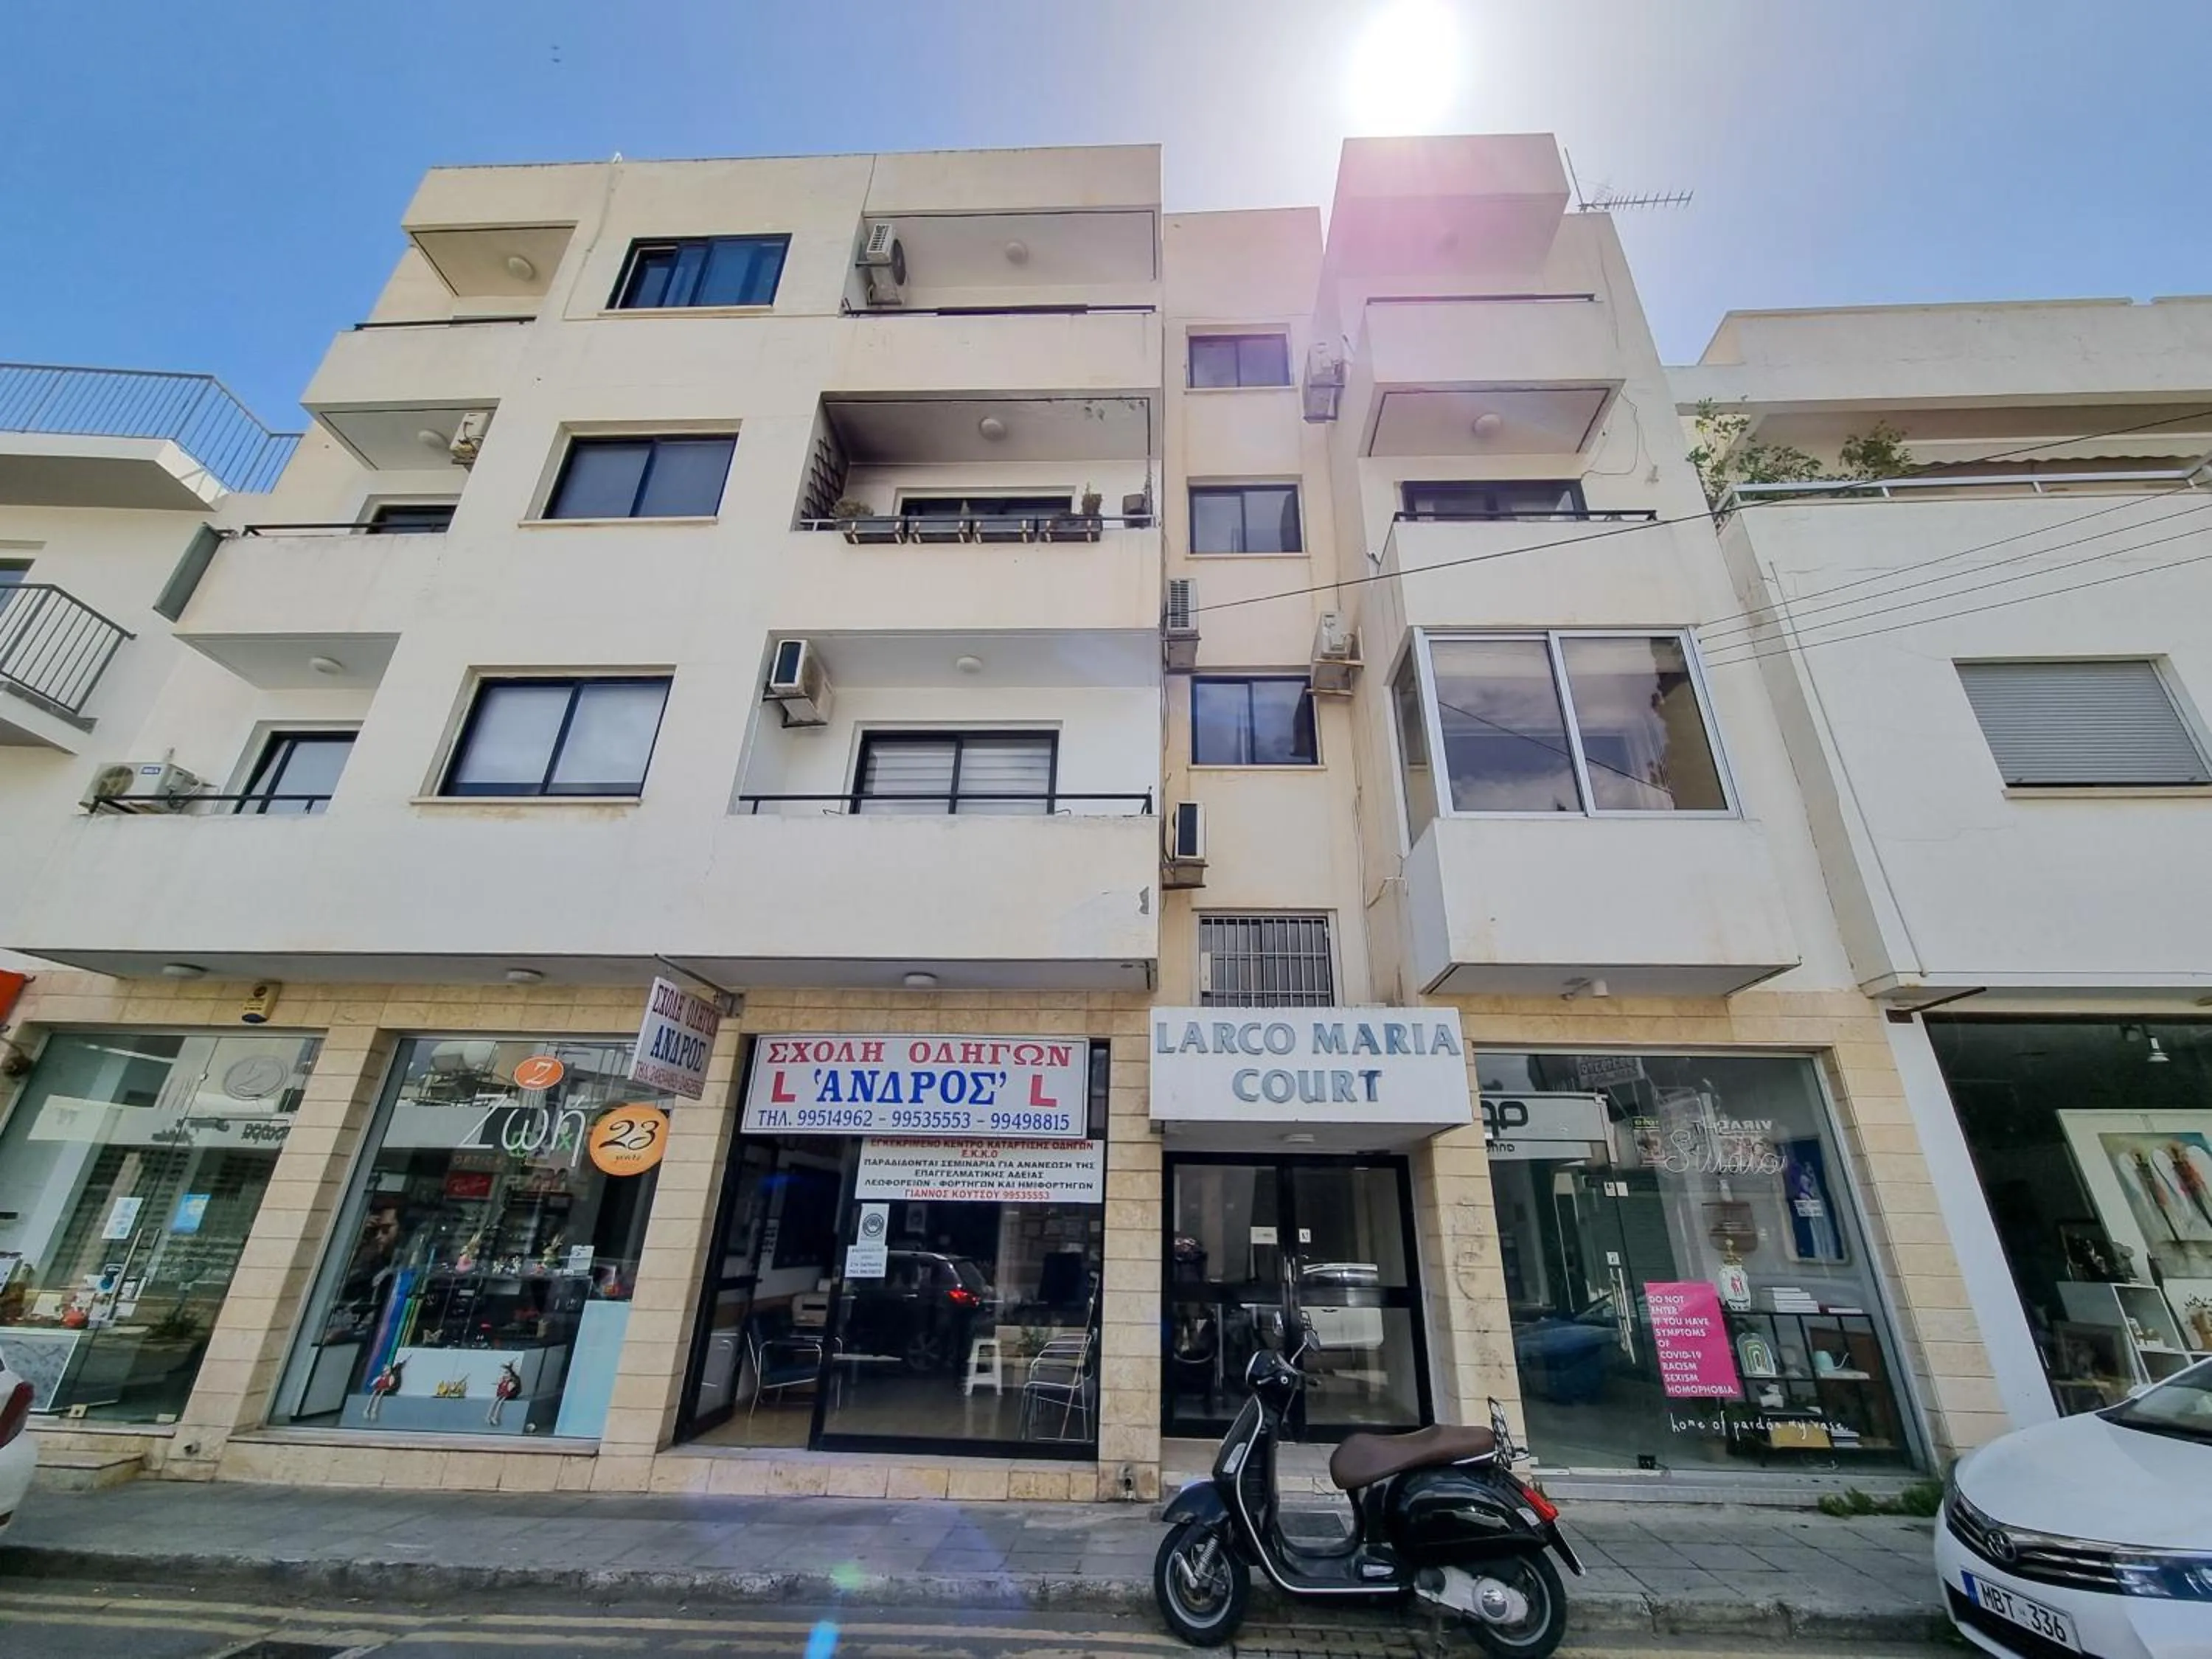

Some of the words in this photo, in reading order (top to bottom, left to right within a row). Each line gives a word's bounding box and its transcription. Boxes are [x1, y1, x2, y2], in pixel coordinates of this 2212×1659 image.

[1155, 1022, 1296, 1055] LARCO
[1312, 1023, 1461, 1056] MARIA
[650, 1024, 706, 1072] ΑΝΔΡΟΣ
[767, 1041, 886, 1064] ΣΧΟΛΗ
[908, 1042, 1073, 1066] ΟΔΗΓΩΝ
[1232, 1068, 1382, 1104] COURT
[758, 1110, 792, 1127] ΤΗΛ.
[797, 1110, 873, 1127] 99514962
[892, 1110, 971, 1129] 99535553
[990, 1113, 1069, 1130] 99498815
[599, 1120, 660, 1150] 23
[864, 1158, 938, 1166] ΠΑΡΑΔΙΔΟΝΤΑΙ
[998, 1161, 1015, 1169] ΓΙΑ
[915, 1169, 1005, 1178] ΕΠΑΓΓΕΛΜΑΤΙΚΗΣ
[1008, 1170, 1044, 1179] ΑΔΕΙΑΣ
[865, 1179, 931, 1187] ΛΕΩΦΟΡΕΙΩΝ
[939, 1180, 995, 1189] ΦΟΡΤΗΓΩΝ
[1018, 1181, 1093, 1189] ΗΜΙΦΟΡΤΗΓΩΝ
[905, 1189, 948, 1198] ΓΙΑΝΝΟΣ
[953, 1190, 998, 1199] ΚΟΥΤΣΟΥ
[1003, 1191, 1050, 1200] 99535553
[1664, 1295, 1684, 1304] NOT
[1685, 1318, 1710, 1326] HAVE
[1655, 1329, 1706, 1337] SYMPTOMS
[1660, 1351, 1703, 1359] COVID-19
[1670, 1413, 1705, 1433] home
[1713, 1411, 1726, 1436] of
[1789, 1420, 1806, 1439] my
[1980, 1582, 2015, 1618] MBT
[2028, 1602, 2067, 1642] 336
